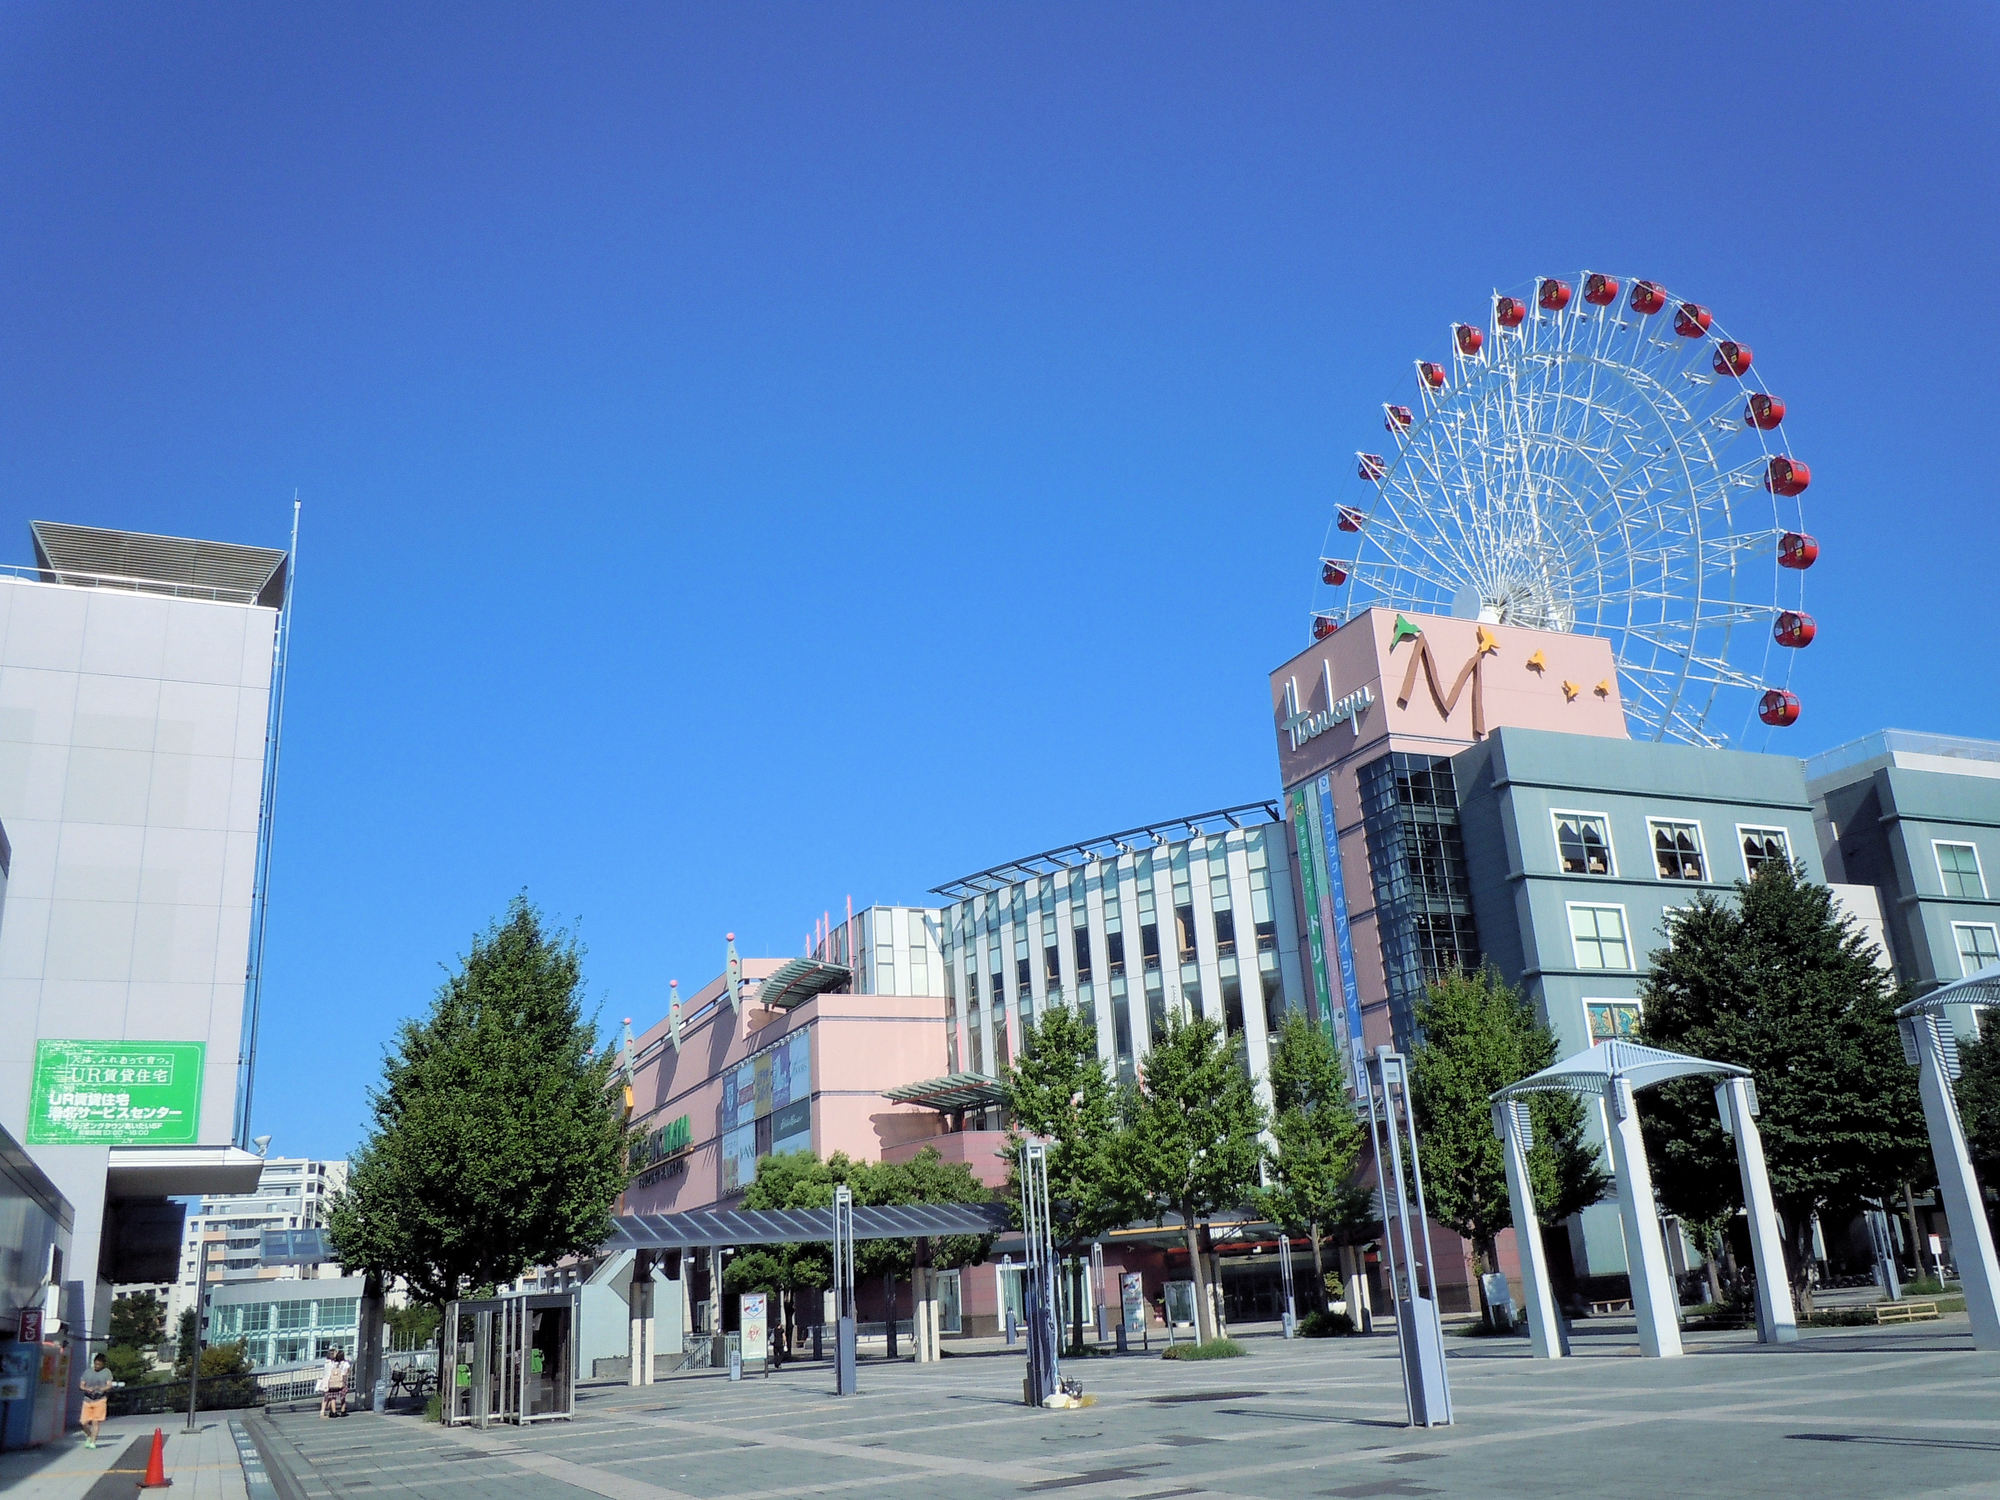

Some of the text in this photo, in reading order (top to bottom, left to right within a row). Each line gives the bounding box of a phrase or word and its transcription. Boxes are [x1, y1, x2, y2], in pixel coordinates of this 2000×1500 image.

[1281, 658, 1376, 752] Hankyu
[71, 1067, 169, 1083] UR賃貸住宅
